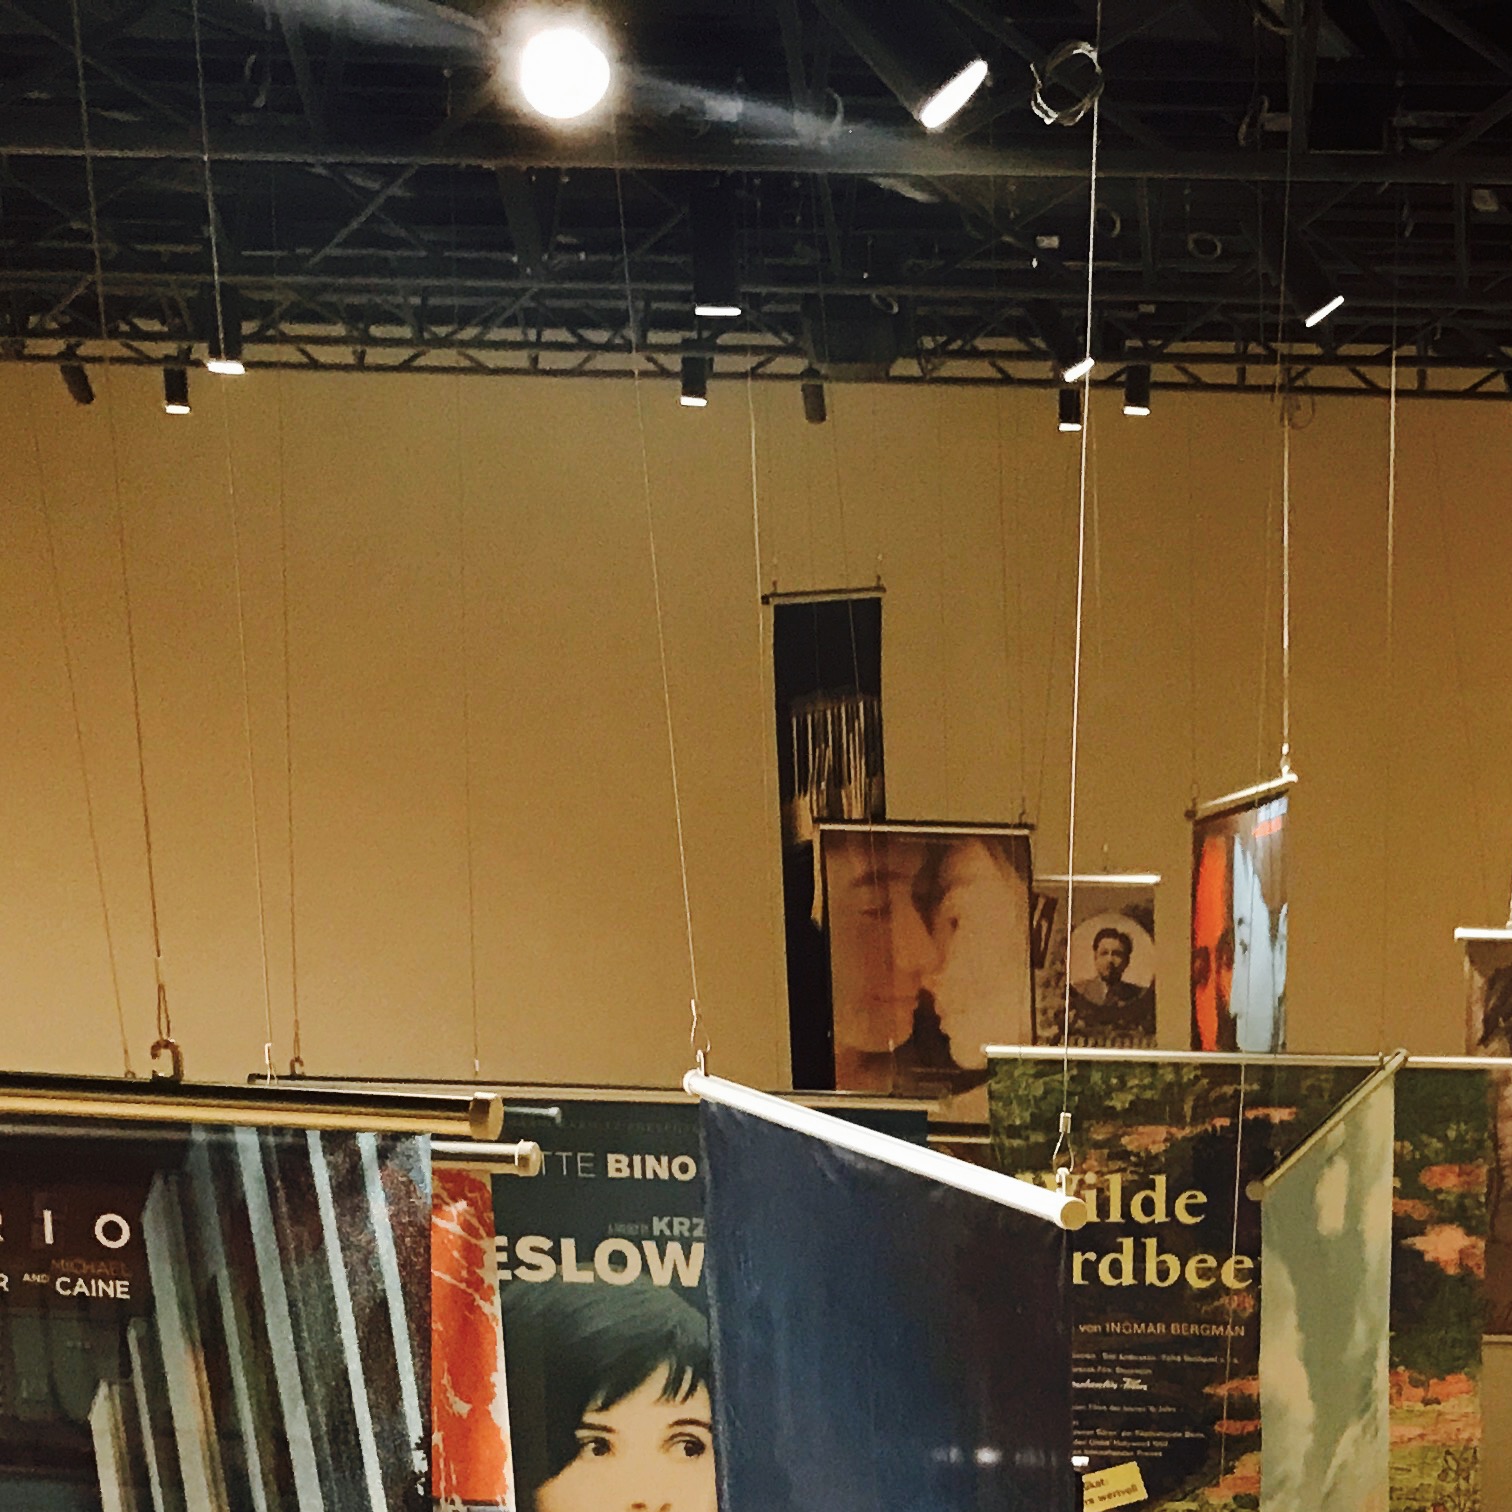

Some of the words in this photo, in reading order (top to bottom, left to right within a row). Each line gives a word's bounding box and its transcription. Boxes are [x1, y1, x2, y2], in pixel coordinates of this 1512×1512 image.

[606, 1153, 698, 1182] BINO
[0, 1208, 132, 1249] IO
[1072, 1236, 1263, 1289] rdbee
[22, 1272, 50, 1284] AND
[55, 1276, 131, 1300] CAINE
[1170, 1322, 1245, 1337] BERGMAN
